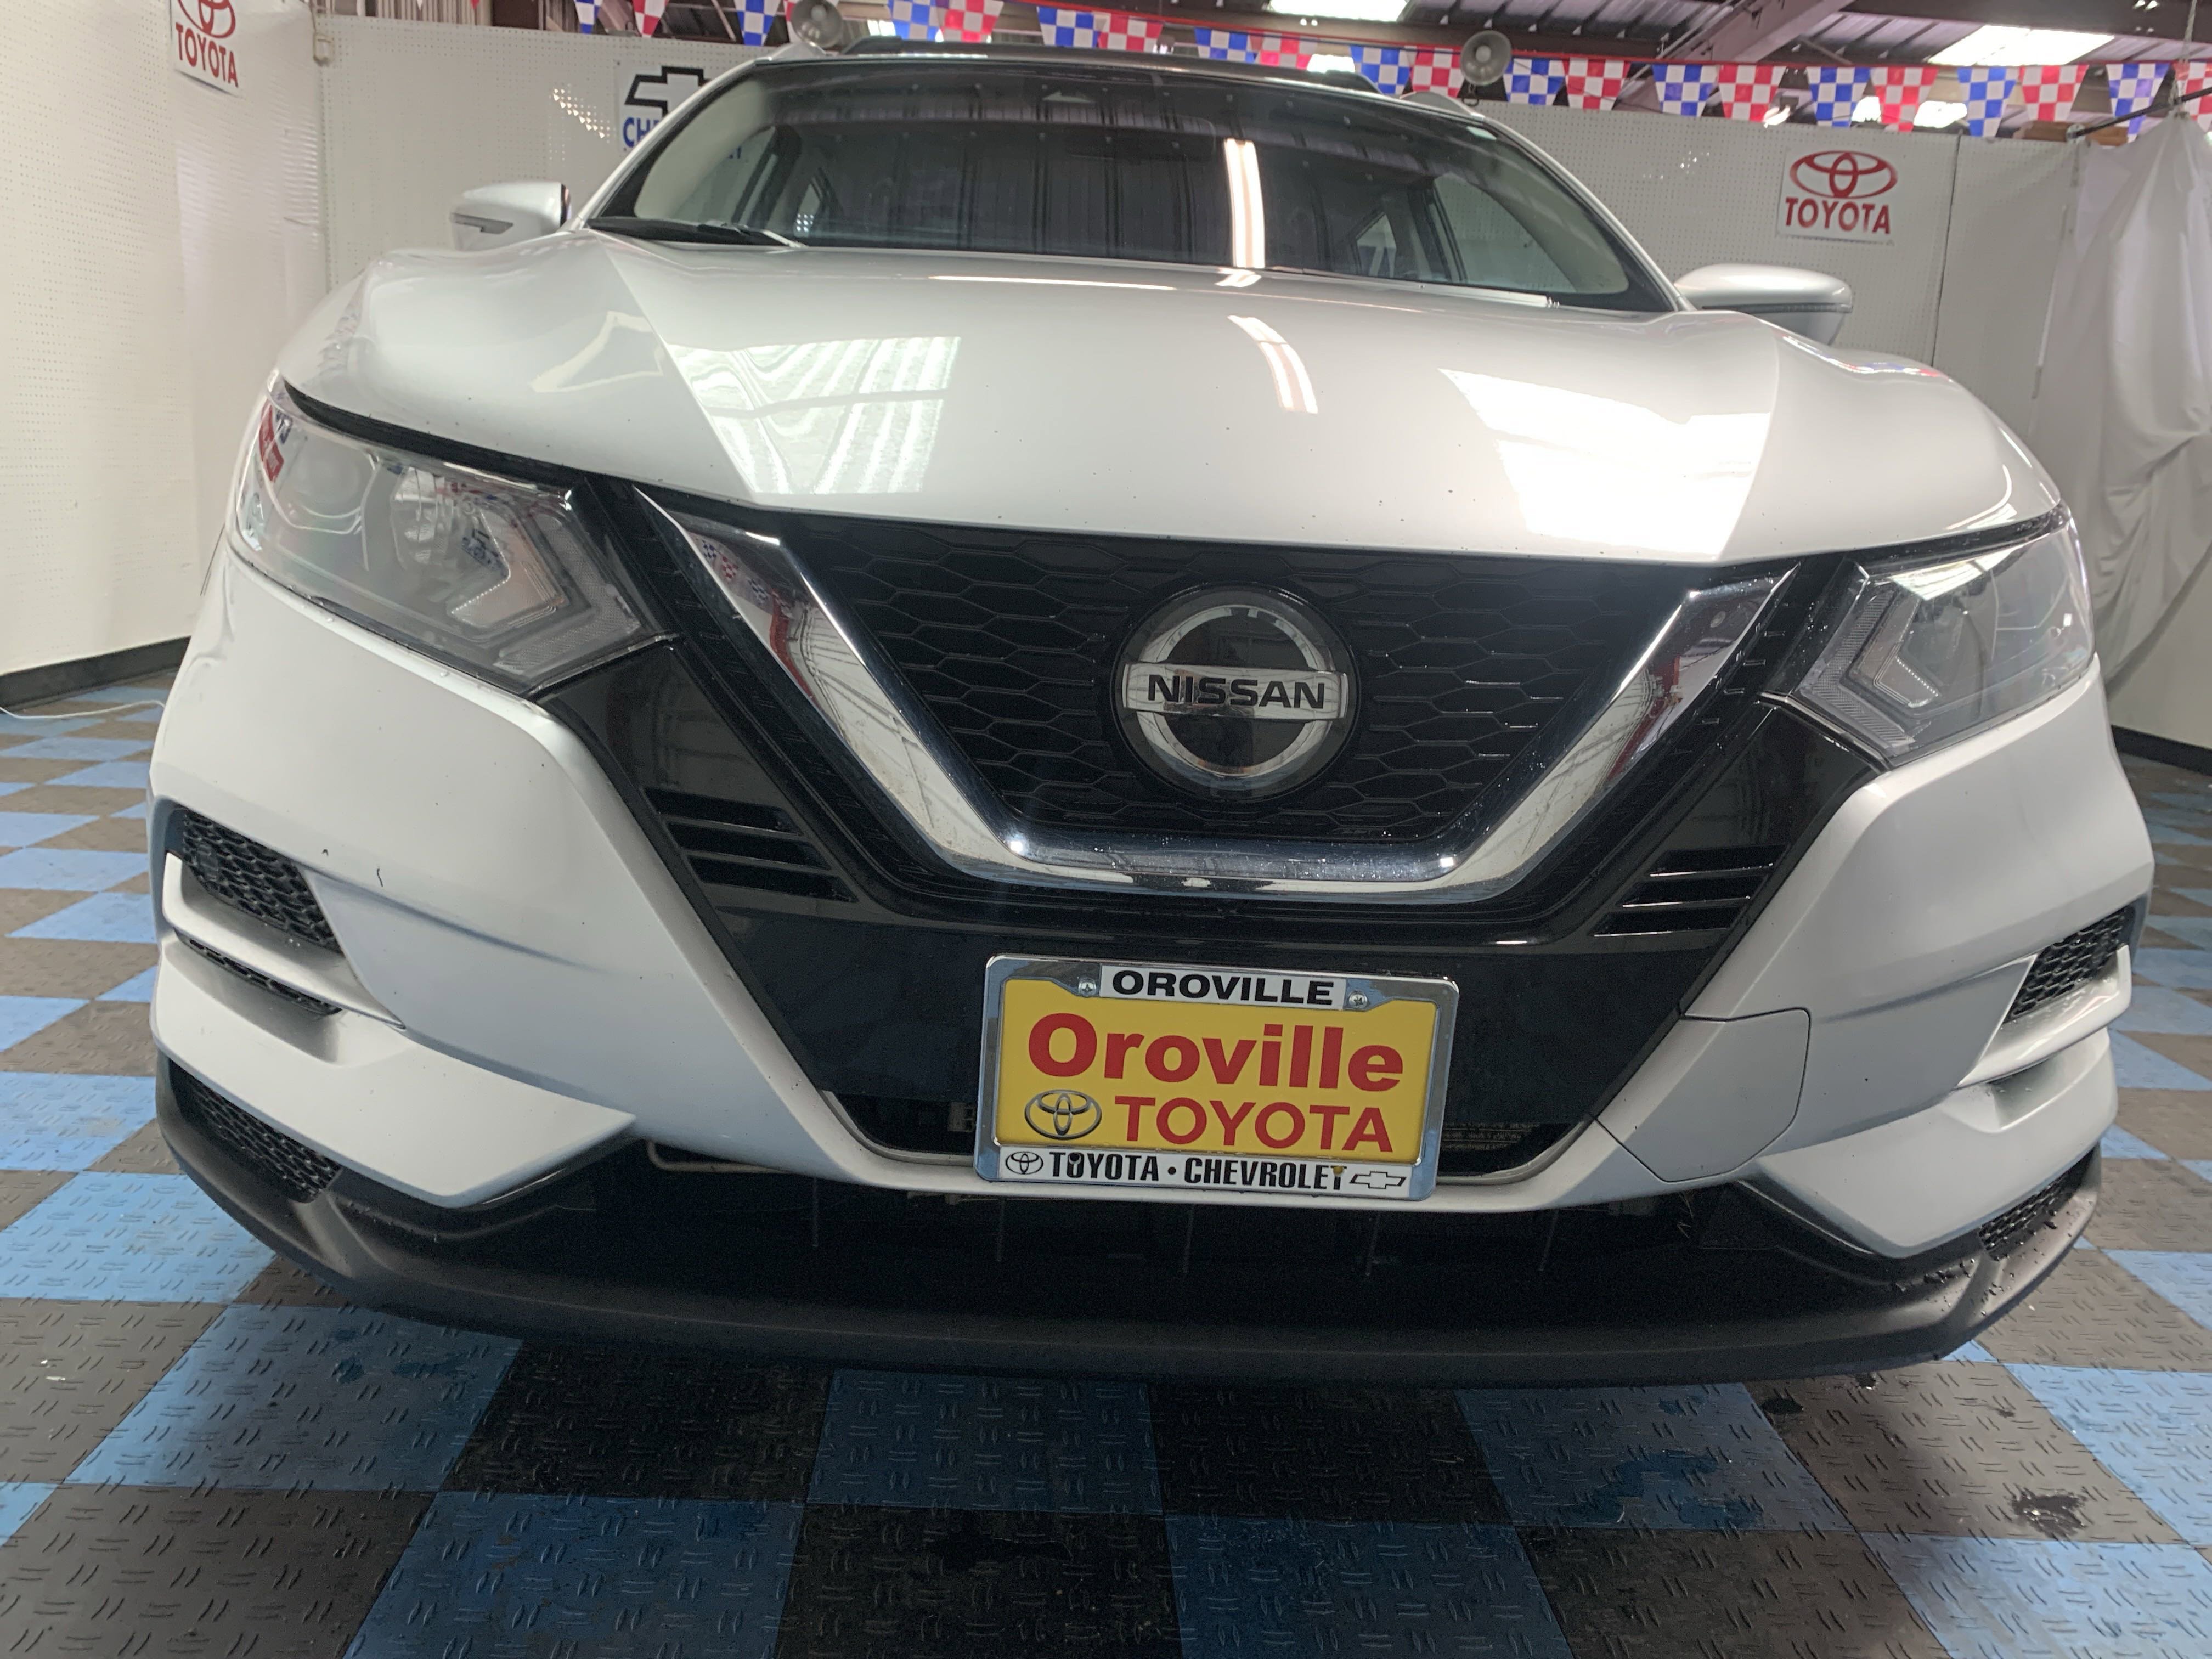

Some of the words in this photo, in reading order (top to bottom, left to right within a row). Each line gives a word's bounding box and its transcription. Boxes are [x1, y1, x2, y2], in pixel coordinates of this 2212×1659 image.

[176, 22, 239, 88] TOYOTA
[1786, 197, 1890, 234] TOYOTA
[1148, 674, 1324, 709] NISSAN
[1113, 970, 1334, 1005] OROVILLE
[1029, 1013, 1403, 1091] Oroville
[1114, 1096, 1393, 1152] TOYOTA
[1049, 1152, 1159, 1181] TOYOTA
[1184, 1158, 1347, 1190] CHEVROLET
